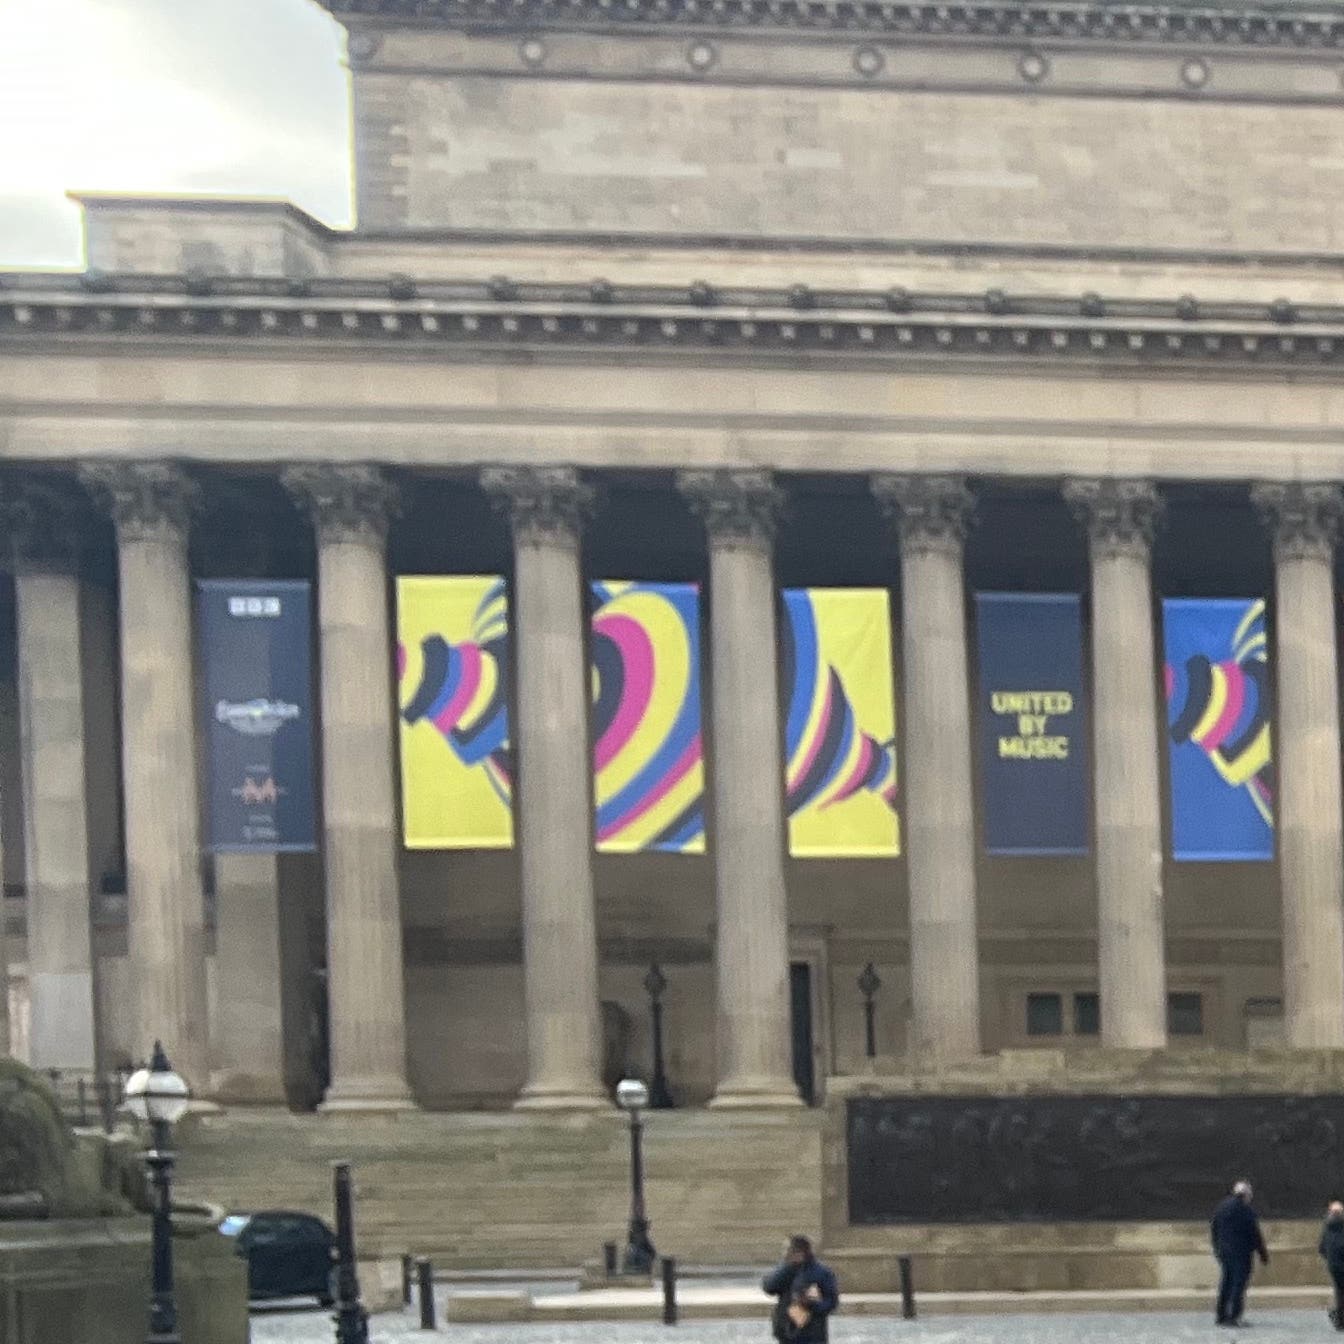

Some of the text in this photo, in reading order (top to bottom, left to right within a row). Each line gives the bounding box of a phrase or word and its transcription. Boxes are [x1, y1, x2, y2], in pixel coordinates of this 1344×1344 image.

[991, 691, 1073, 714] UNITED
[1019, 715, 1047, 735] BY
[998, 736, 1069, 759] MUSIC
